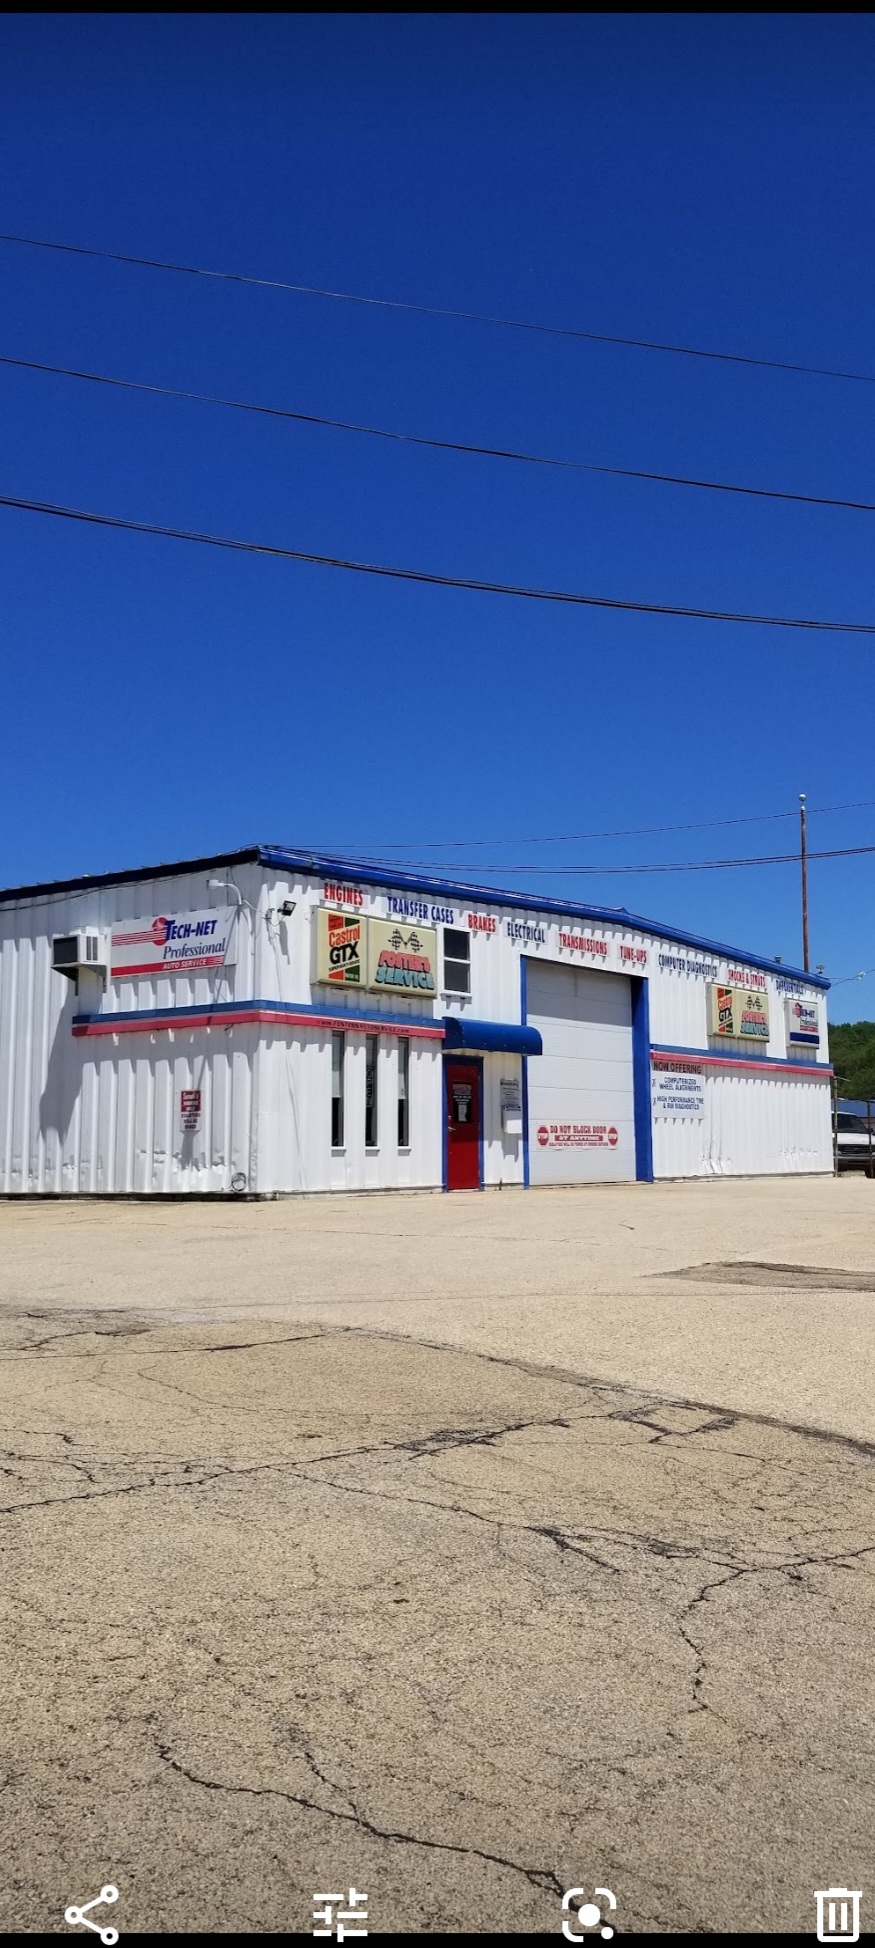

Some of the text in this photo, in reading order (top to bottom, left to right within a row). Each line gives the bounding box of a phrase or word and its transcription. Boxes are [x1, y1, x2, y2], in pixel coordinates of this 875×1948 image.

[324, 882, 363, 906] ENGINES
[387, 896, 454, 924] TRANSFER CASES
[165, 920, 217, 941] TECH-NET
[468, 914, 496, 933] BRAKES
[507, 922, 546, 943] ELECTRICAL
[328, 925, 360, 947] Castrol
[559, 933, 607, 956] TRANSMISSIONS
[163, 937, 226, 960] Professional
[329, 941, 359, 965] GTX
[620, 946, 647, 964] TUNE-UPS
[180, 959, 207, 968] SERVICE
[658, 954, 718, 978] COMPUTER DIAGNOSTICS
[375, 966, 435, 990] SERVICE
[728, 969, 766, 987] SHOCKS & STRUTS
[719, 1005, 732, 1022] GTX
[654, 1061, 701, 1074] NOW OFFERING
[550, 1125, 606, 1134] DO NOT BLOCK DOOR
